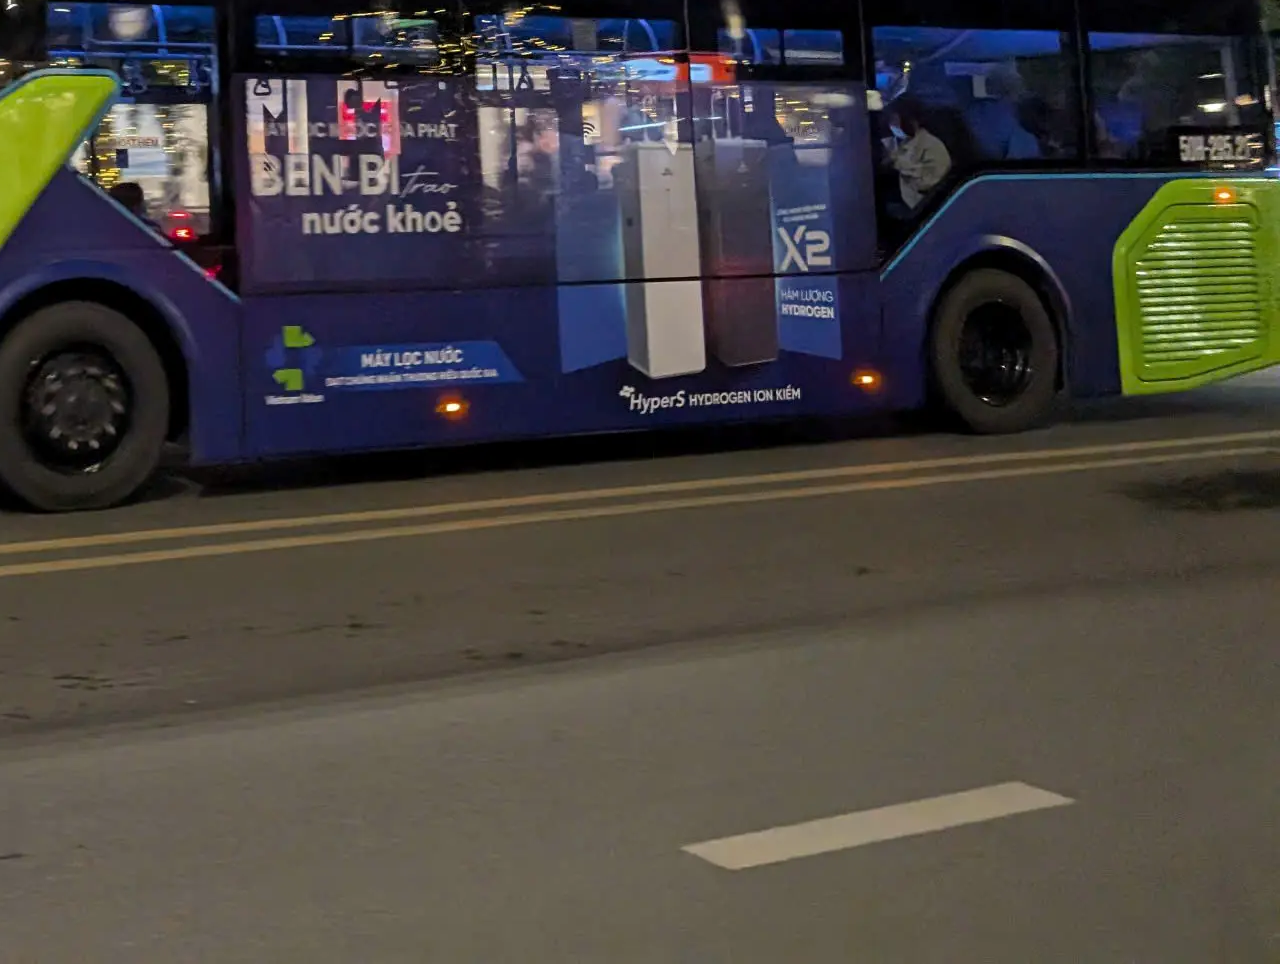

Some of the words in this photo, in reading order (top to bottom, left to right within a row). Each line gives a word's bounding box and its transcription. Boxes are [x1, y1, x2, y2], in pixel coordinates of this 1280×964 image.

[302, 203, 381, 234] nước
[386, 201, 462, 233] khoẻ
[778, 225, 832, 272] X2
[781, 303, 835, 319] HYDROGEN
[629, 389, 686, 414] HyperS
[689, 390, 752, 407] HYDROGEN
[754, 388, 774, 402] ION
